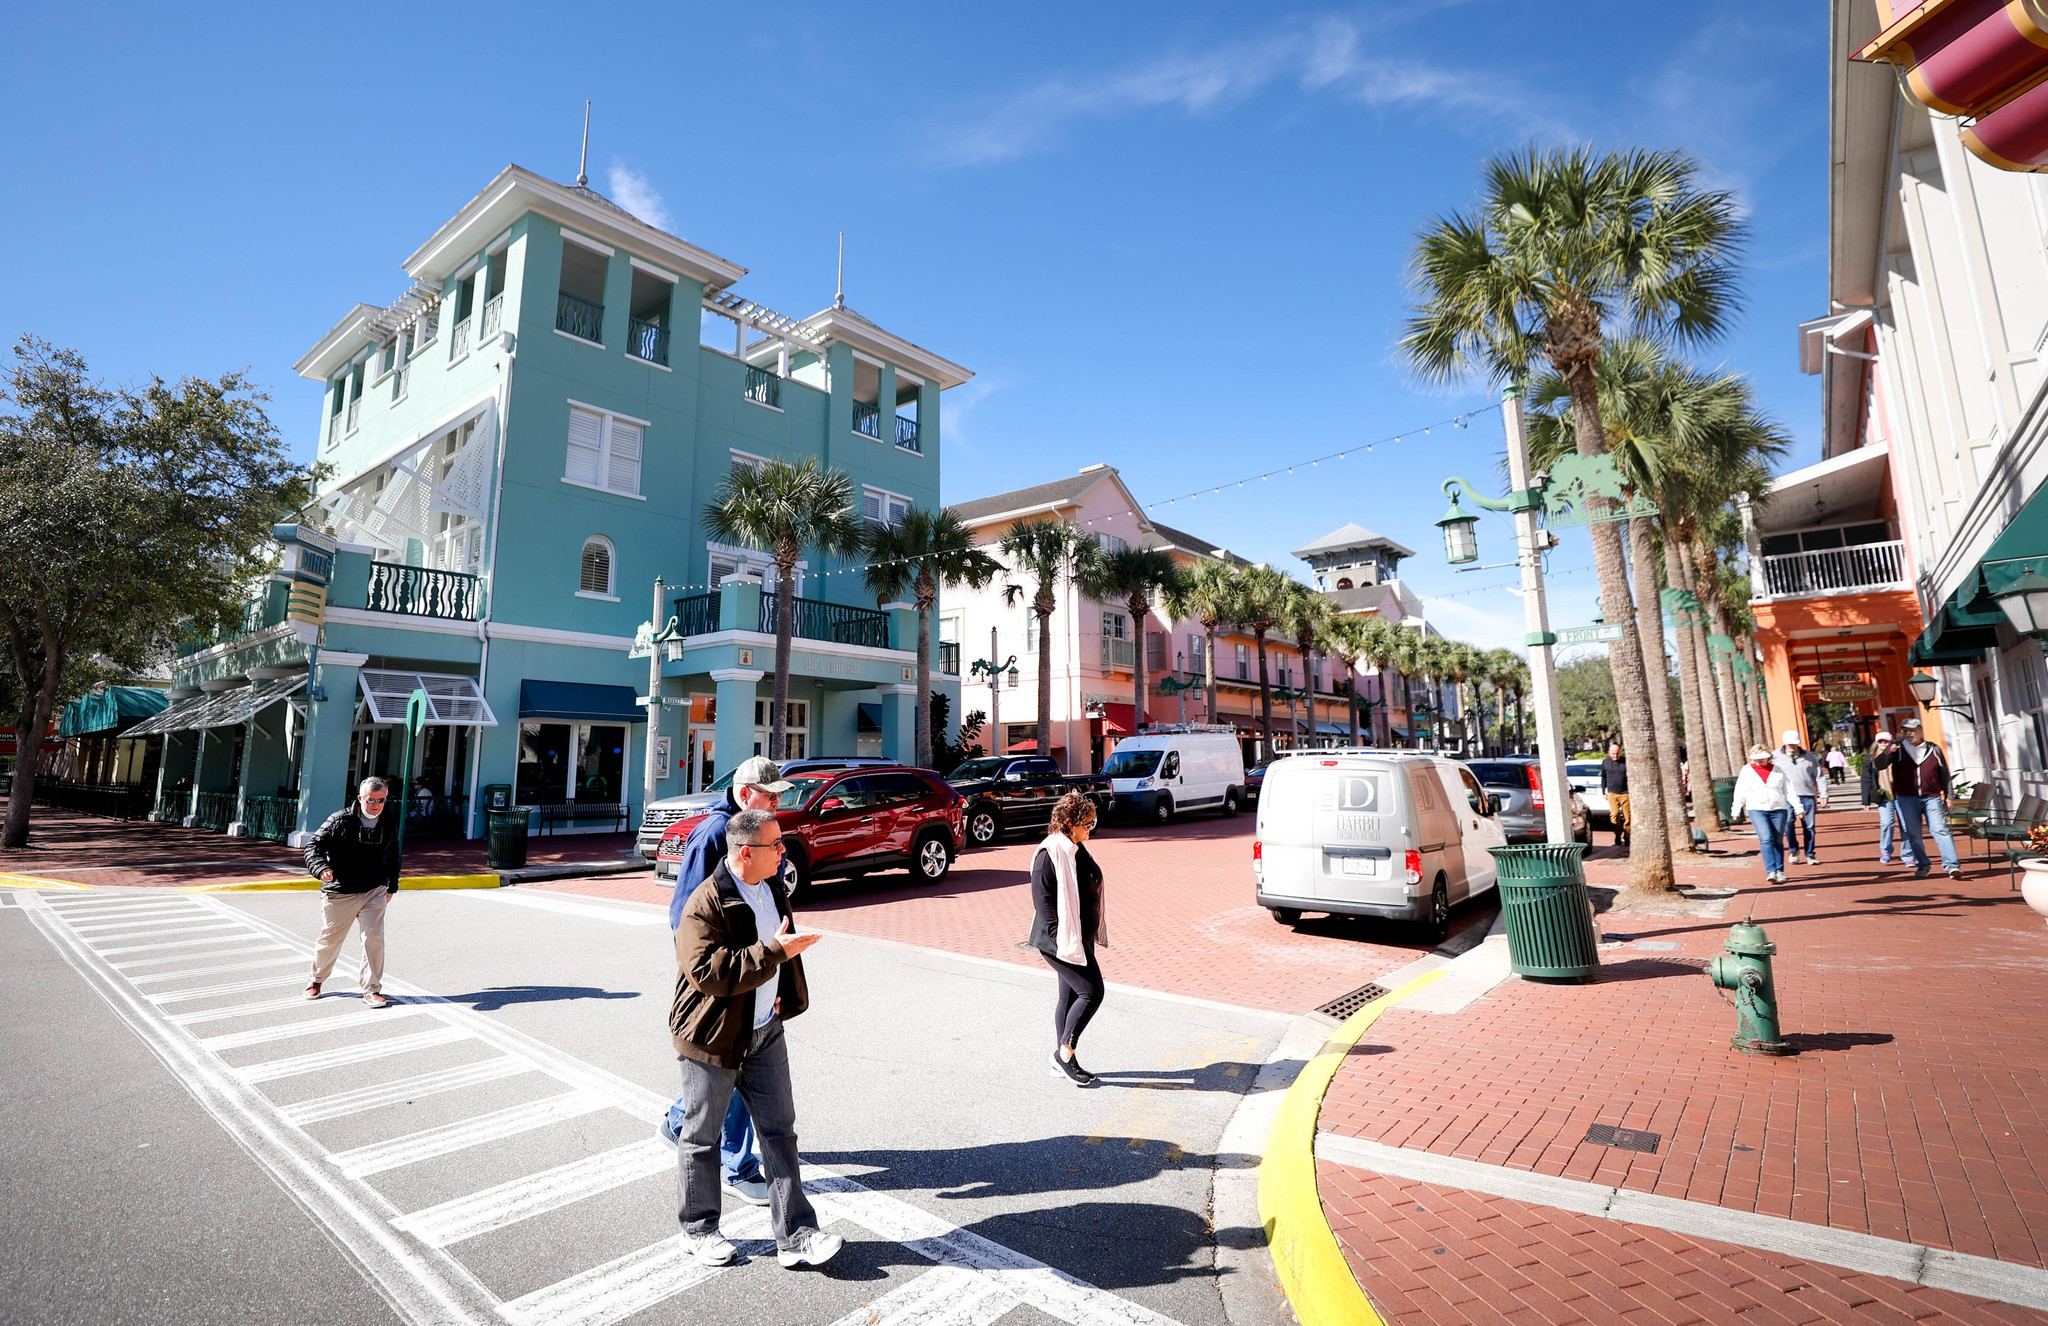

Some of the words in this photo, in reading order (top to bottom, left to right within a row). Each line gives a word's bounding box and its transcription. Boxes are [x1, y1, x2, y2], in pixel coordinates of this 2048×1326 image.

[298, 530, 334, 552] DOWNTOWN
[301, 549, 333, 578] DINER
[1567, 627, 1599, 641] FRONT
[1824, 689, 1873, 698] Dazzling
[1340, 777, 1375, 808] D
[1337, 815, 1381, 832] DARBO
[1336, 831, 1360, 840] DESIGN
[1361, 832, 1381, 841] BUILD
